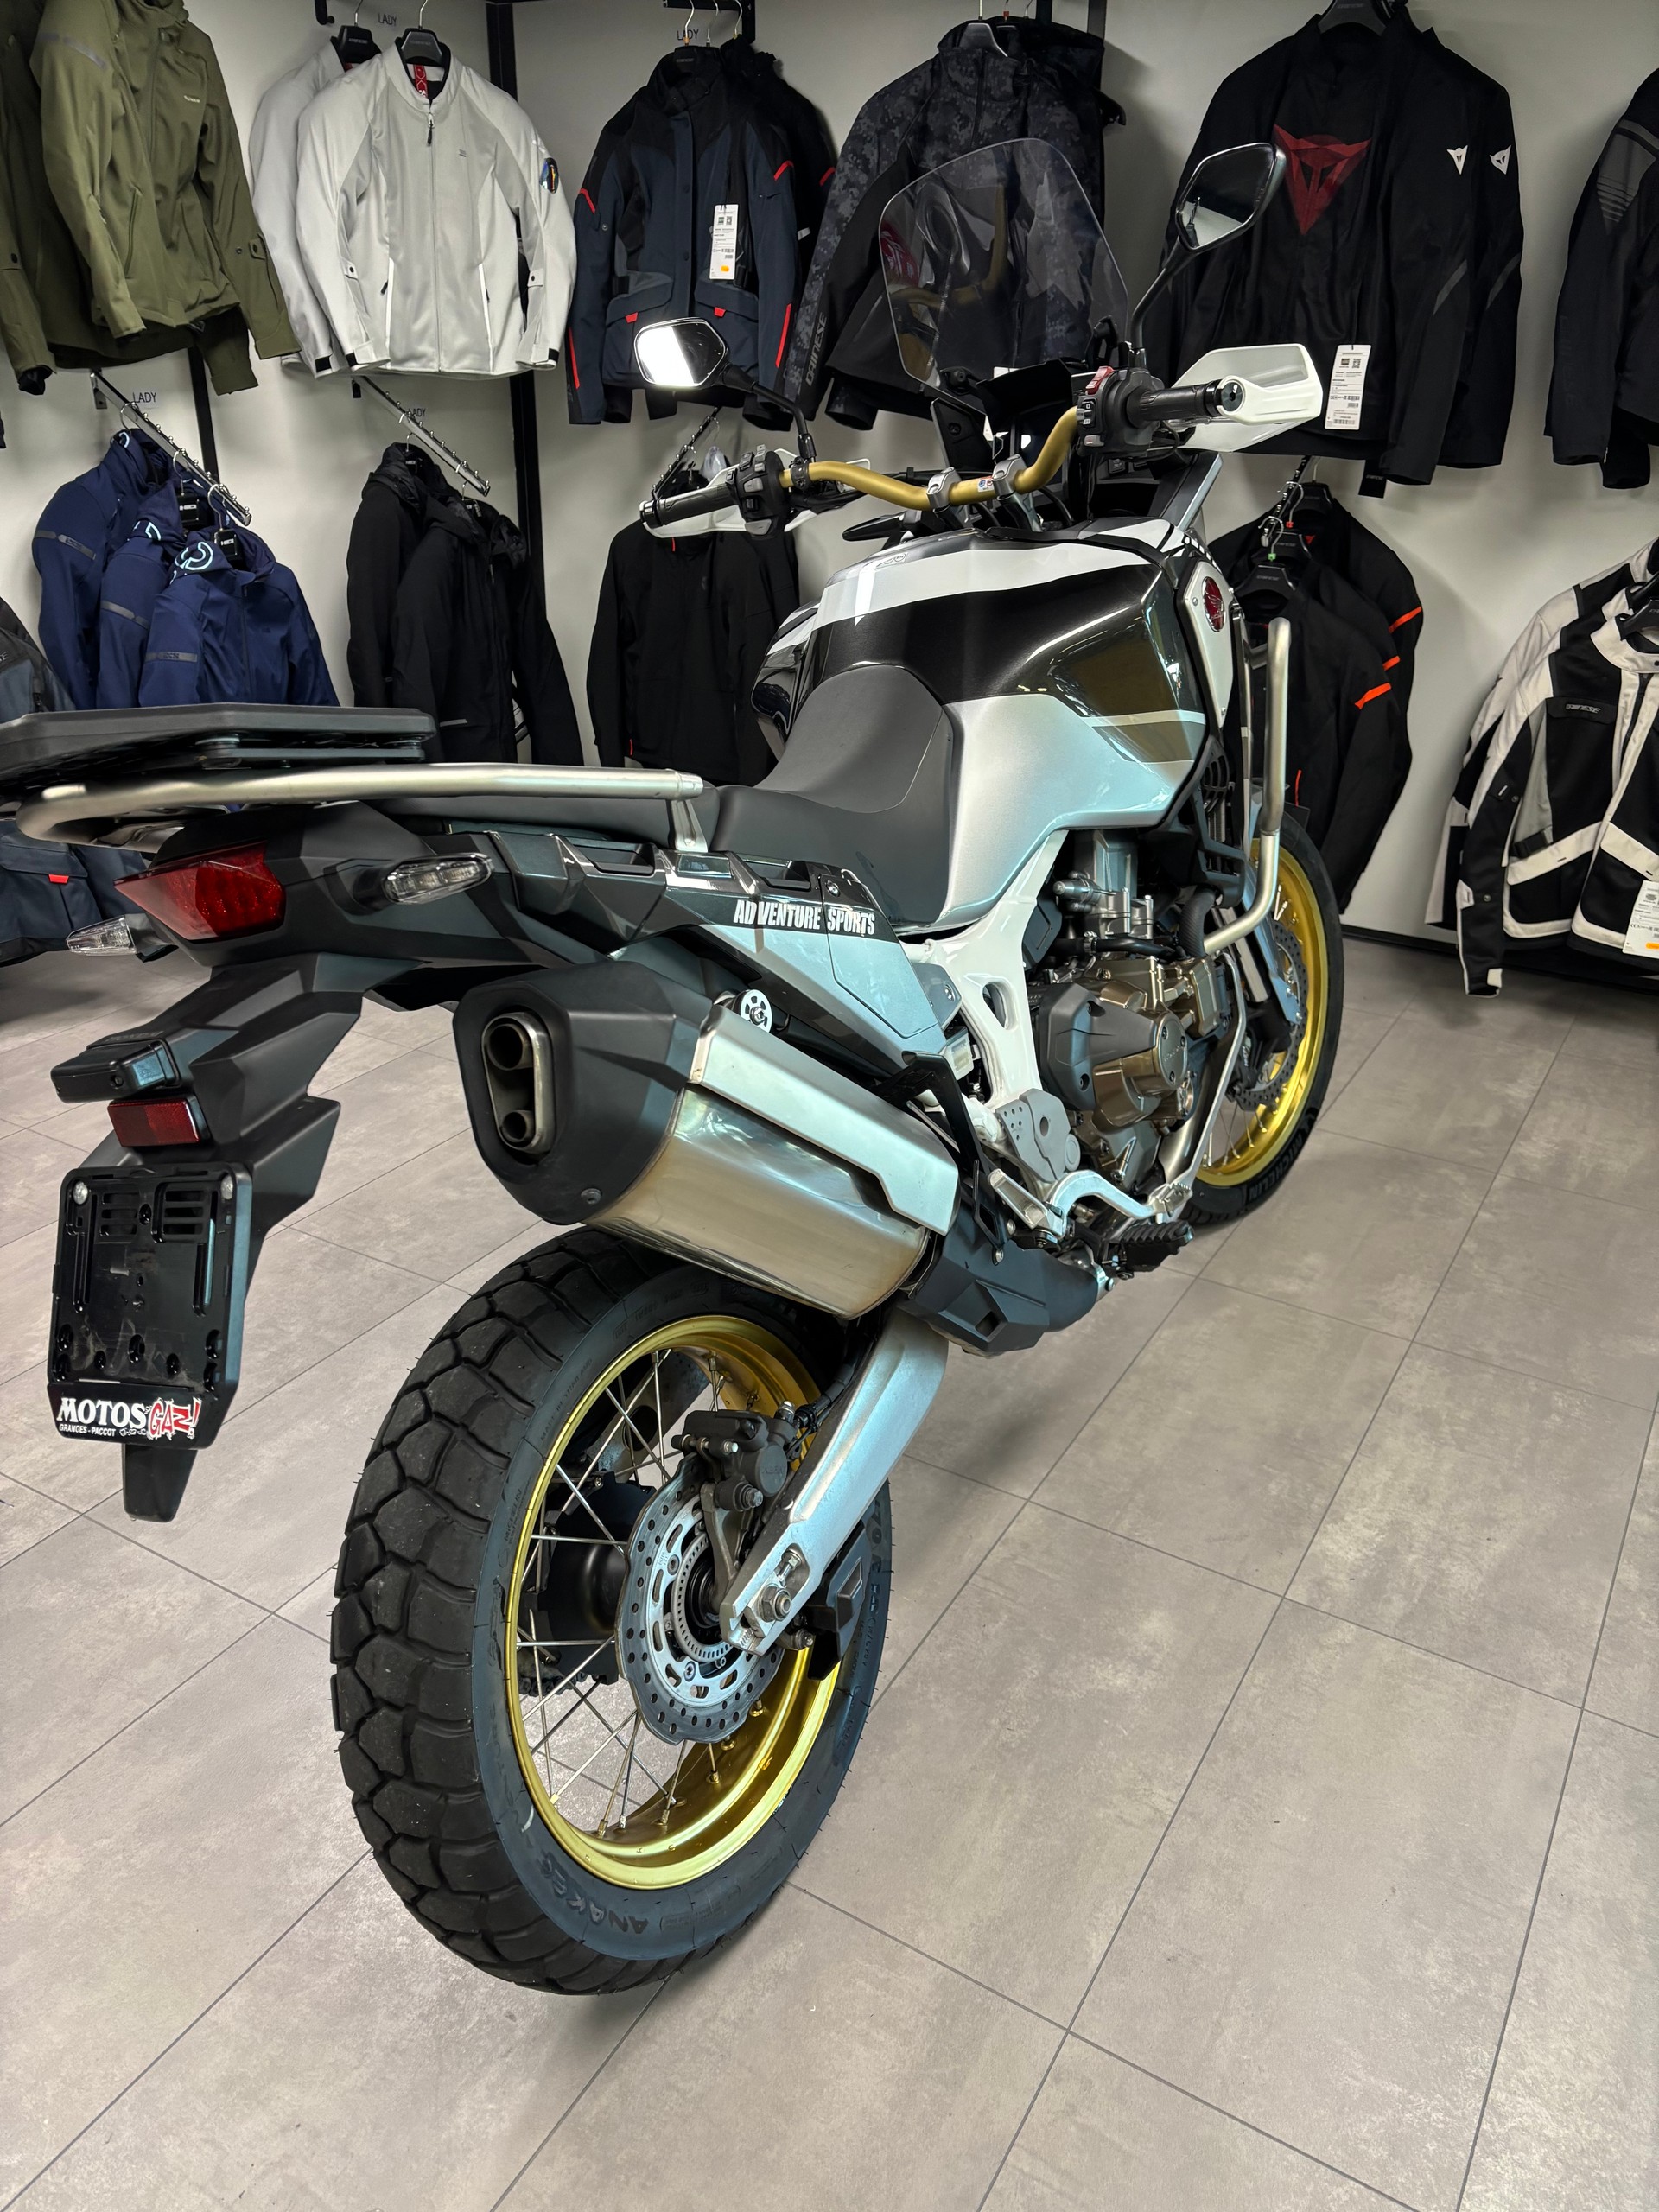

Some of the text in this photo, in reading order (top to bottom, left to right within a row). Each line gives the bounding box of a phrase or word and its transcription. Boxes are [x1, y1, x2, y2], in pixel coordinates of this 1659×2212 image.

[378, 13, 397, 26] LADY
[805, 312, 827, 386] DAINESE
[132, 391, 156, 404] LADY
[408, 408, 426, 417] ADY
[734, 899, 875, 935] ADVENTURE SPORTS
[56, 1397, 147, 1429] MOTOS
